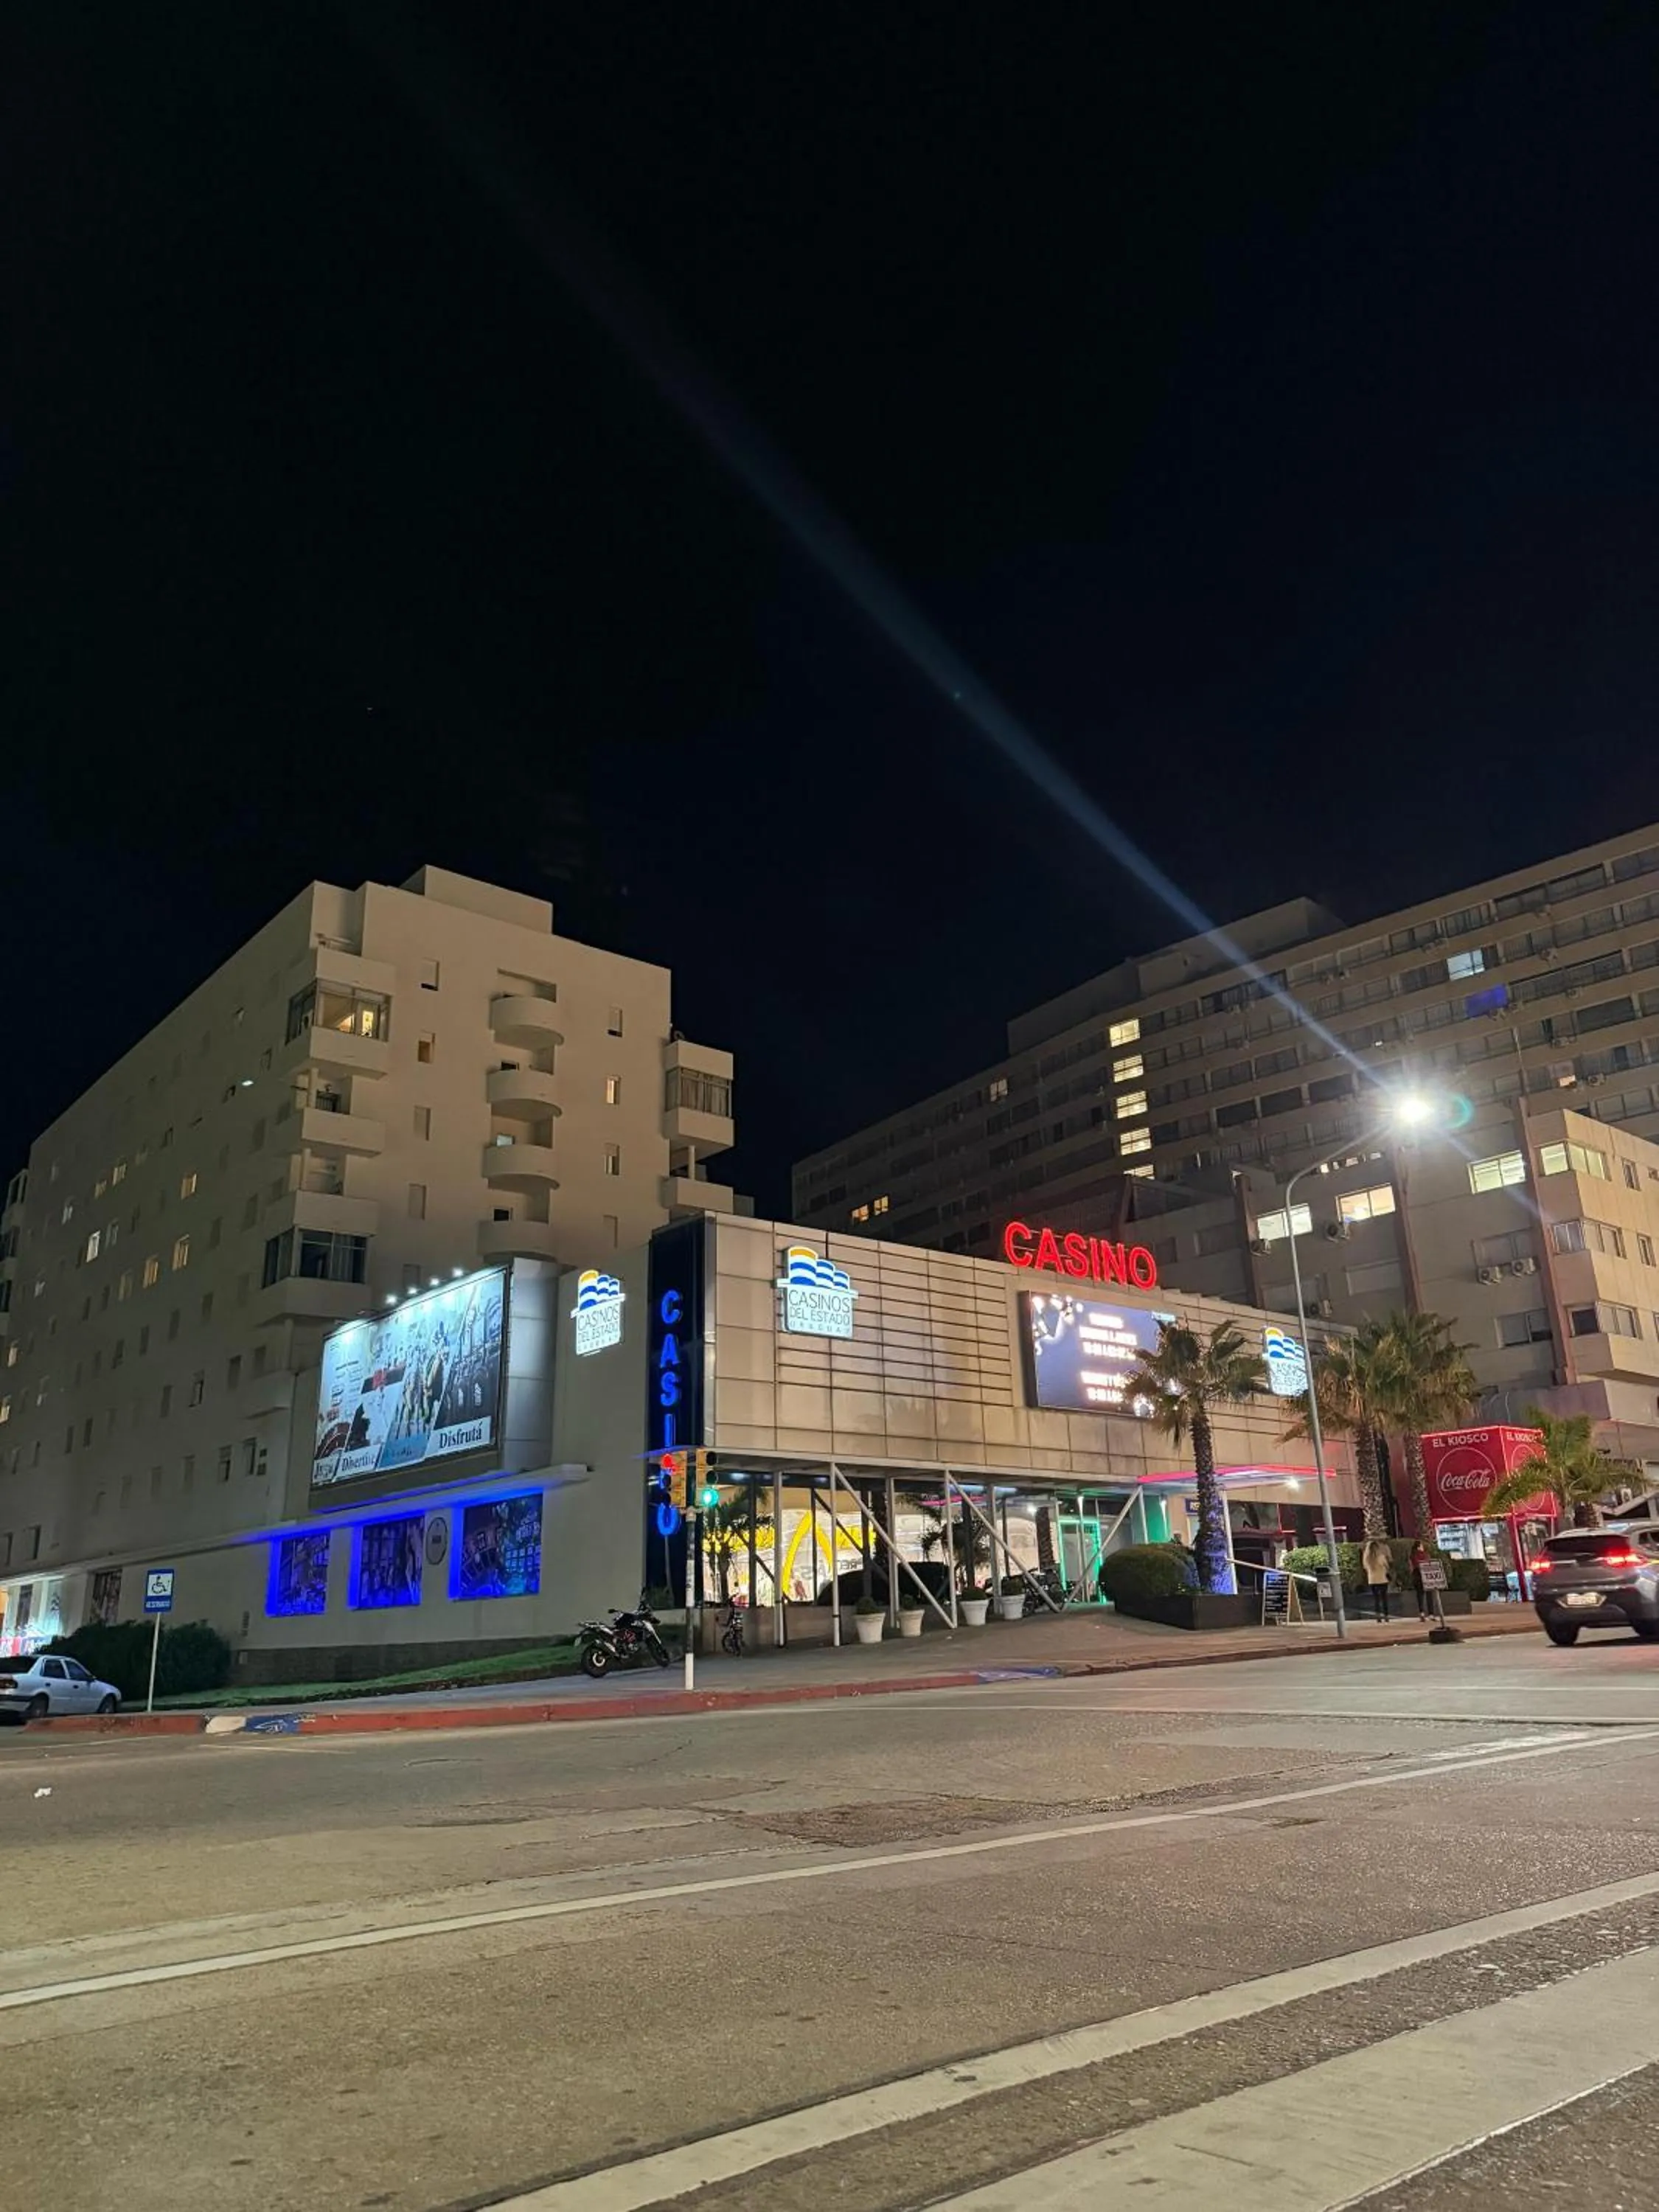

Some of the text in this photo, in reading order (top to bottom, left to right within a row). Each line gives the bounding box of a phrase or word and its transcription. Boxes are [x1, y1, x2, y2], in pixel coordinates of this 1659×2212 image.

[1005, 1221, 1157, 1290] CASINO
[789, 1290, 850, 1313] CASINOS
[578, 1304, 619, 1331] CASINOS
[790, 1306, 850, 1326] DEL ESTADO
[439, 1421, 482, 1448] Disfrutá
[1433, 1433, 1489, 1447] EL KIOSCO
